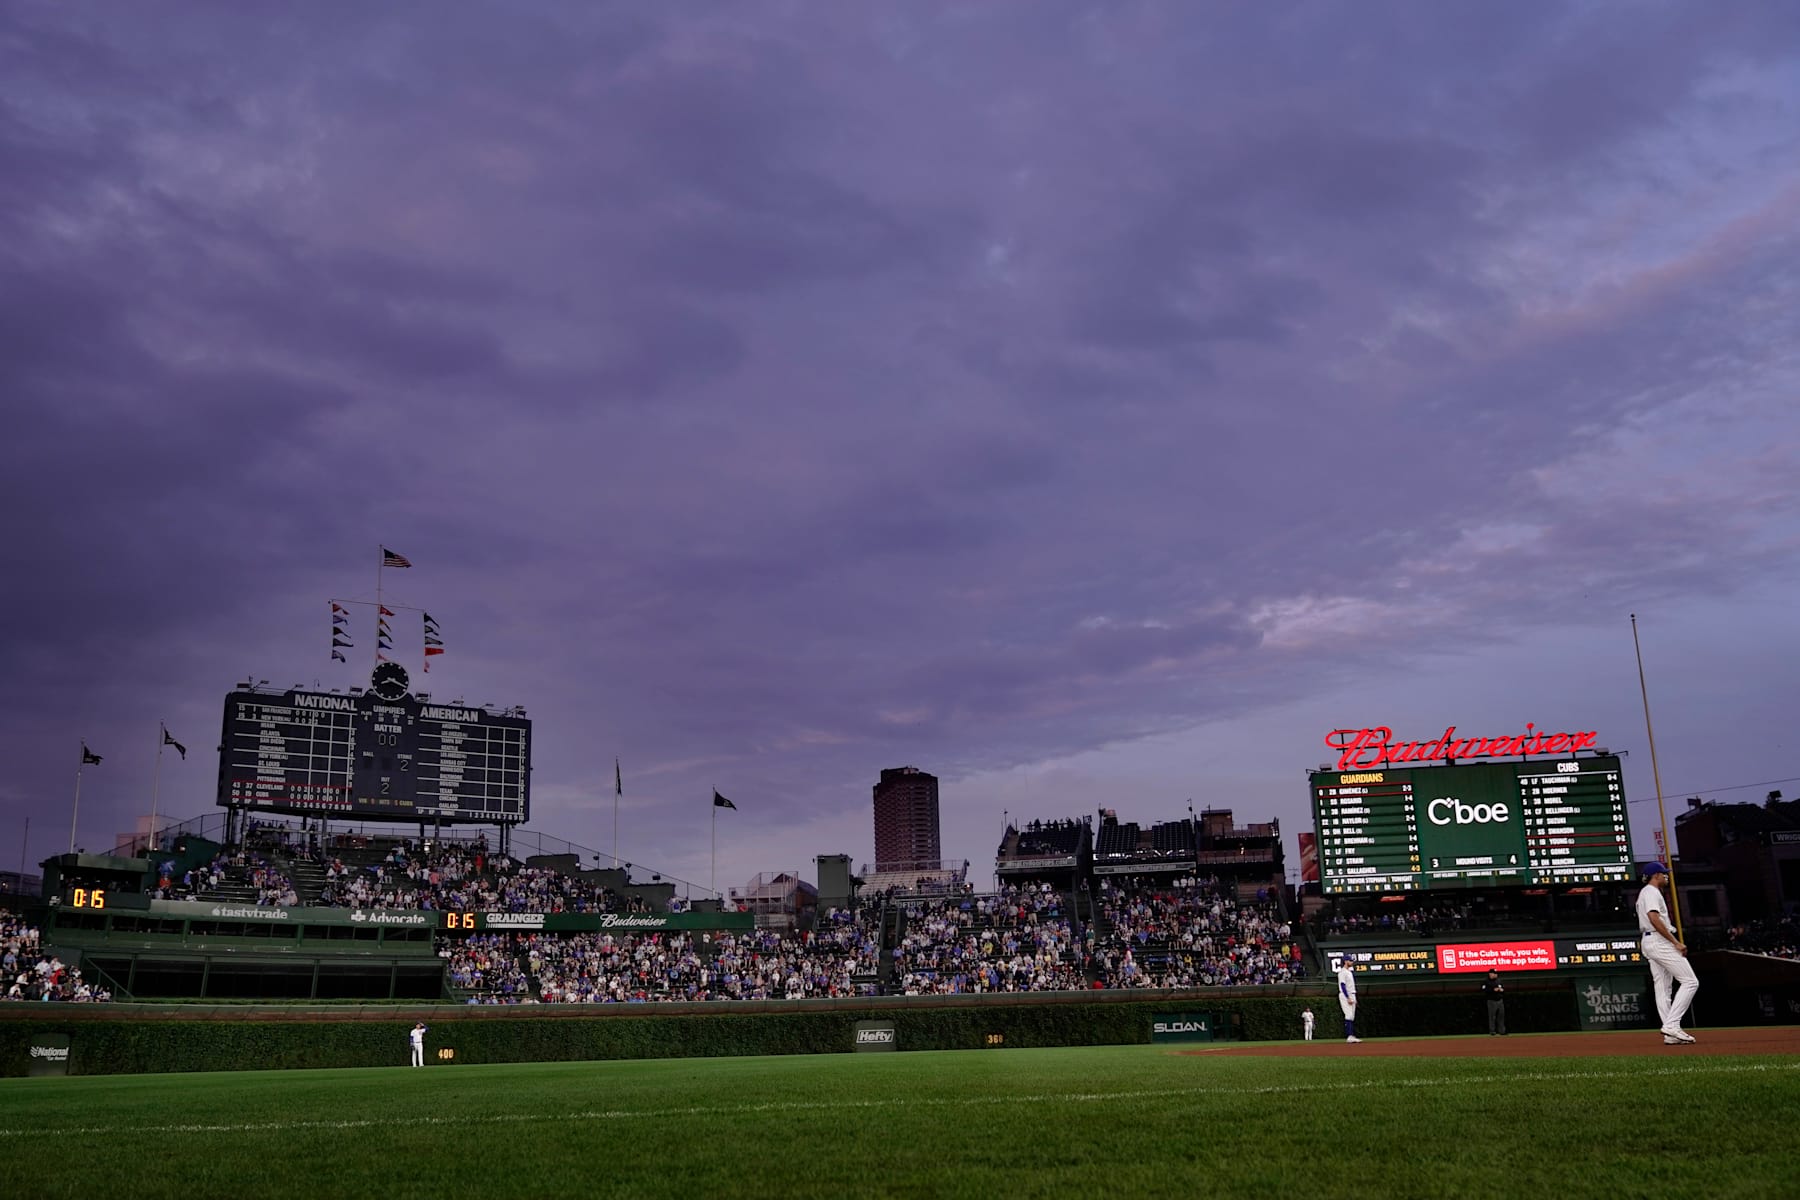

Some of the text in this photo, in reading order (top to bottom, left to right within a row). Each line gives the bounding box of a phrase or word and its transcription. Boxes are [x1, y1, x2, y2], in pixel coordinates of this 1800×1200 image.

[294, 694, 358, 711] NATIONAL
[373, 705, 405, 715] UMPIRES
[420, 706, 479, 722] AMERICAN
[374, 724, 402, 733] BATTER
[1325, 722, 1597, 770] Budweiser
[400, 760, 408, 771] 2
[1557, 762, 1579, 772] CUBS
[1340, 773, 1384, 784] GUARDIANS
[381, 783, 389, 794] 2
[1428, 797, 1509, 825] Cboe
[1432, 858, 1439, 867] 3
[1510, 855, 1516, 864] 4
[73, 888, 105, 909] 0:15
[368, 912, 425, 924] Advocate
[446, 912, 474, 929] 0:15
[486, 913, 545, 923] GRAINGER
[600, 914, 667, 927] Budweiser
[1358, 953, 1372, 961] RHP
[1500, 949, 1516, 957] win,
[1601, 954, 1616, 962] 2.24
[1631, 953, 1640, 961] 32
[1460, 958, 1496, 968] Download
[1512, 958, 1526, 966] app
[1528, 957, 1551, 965] today.
[1587, 993, 1639, 1006] DRAFT
[1595, 1003, 1640, 1014] KINGS
[1589, 1014, 1646, 1023] SPORTSBOOK
[1154, 1021, 1206, 1033] SLOAN
[860, 1032, 891, 1041] Hefty
[38, 1046, 70, 1056] National
[438, 1048, 454, 1059] 400
